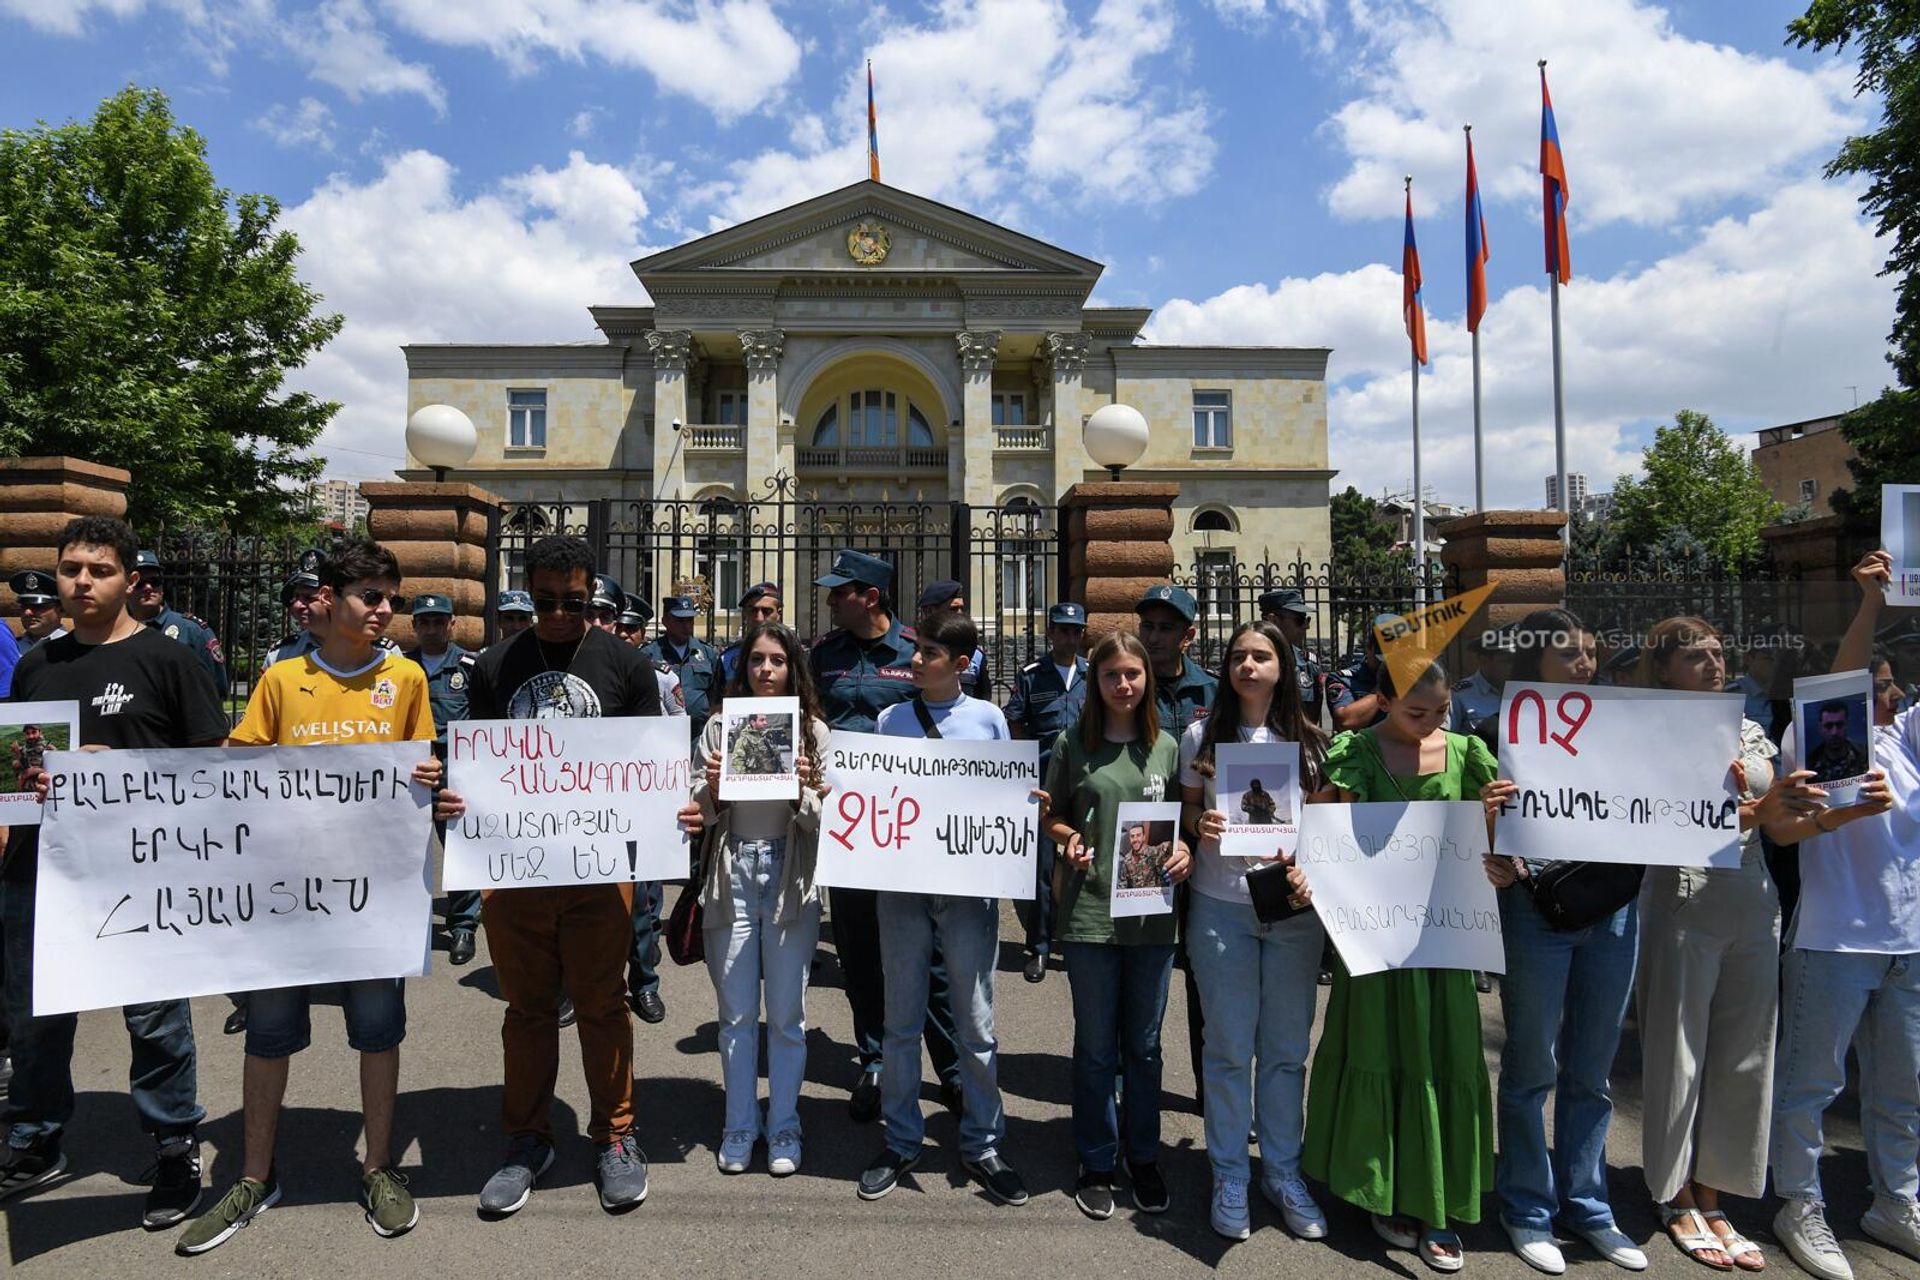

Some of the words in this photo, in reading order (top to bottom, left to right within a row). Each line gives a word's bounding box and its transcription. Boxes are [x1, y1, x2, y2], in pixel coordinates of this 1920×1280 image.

[291, 720, 392, 738] WELLSTAR
[454, 724, 566, 761] ԻՐԱԿԱՆ
[1508, 688, 1594, 757] ՈՉ
[131, 822, 251, 865] ԵՐԿԻՐ
[462, 808, 632, 841] ԱԶԱՏՈՒԹՅԱՆ
[935, 813, 1036, 858] ՎԱԽԵՑՆԻ
[487, 845, 549, 882] ՄԵՋ
[96, 876, 370, 940] ՀԱՅԱՍՏԱՆ
